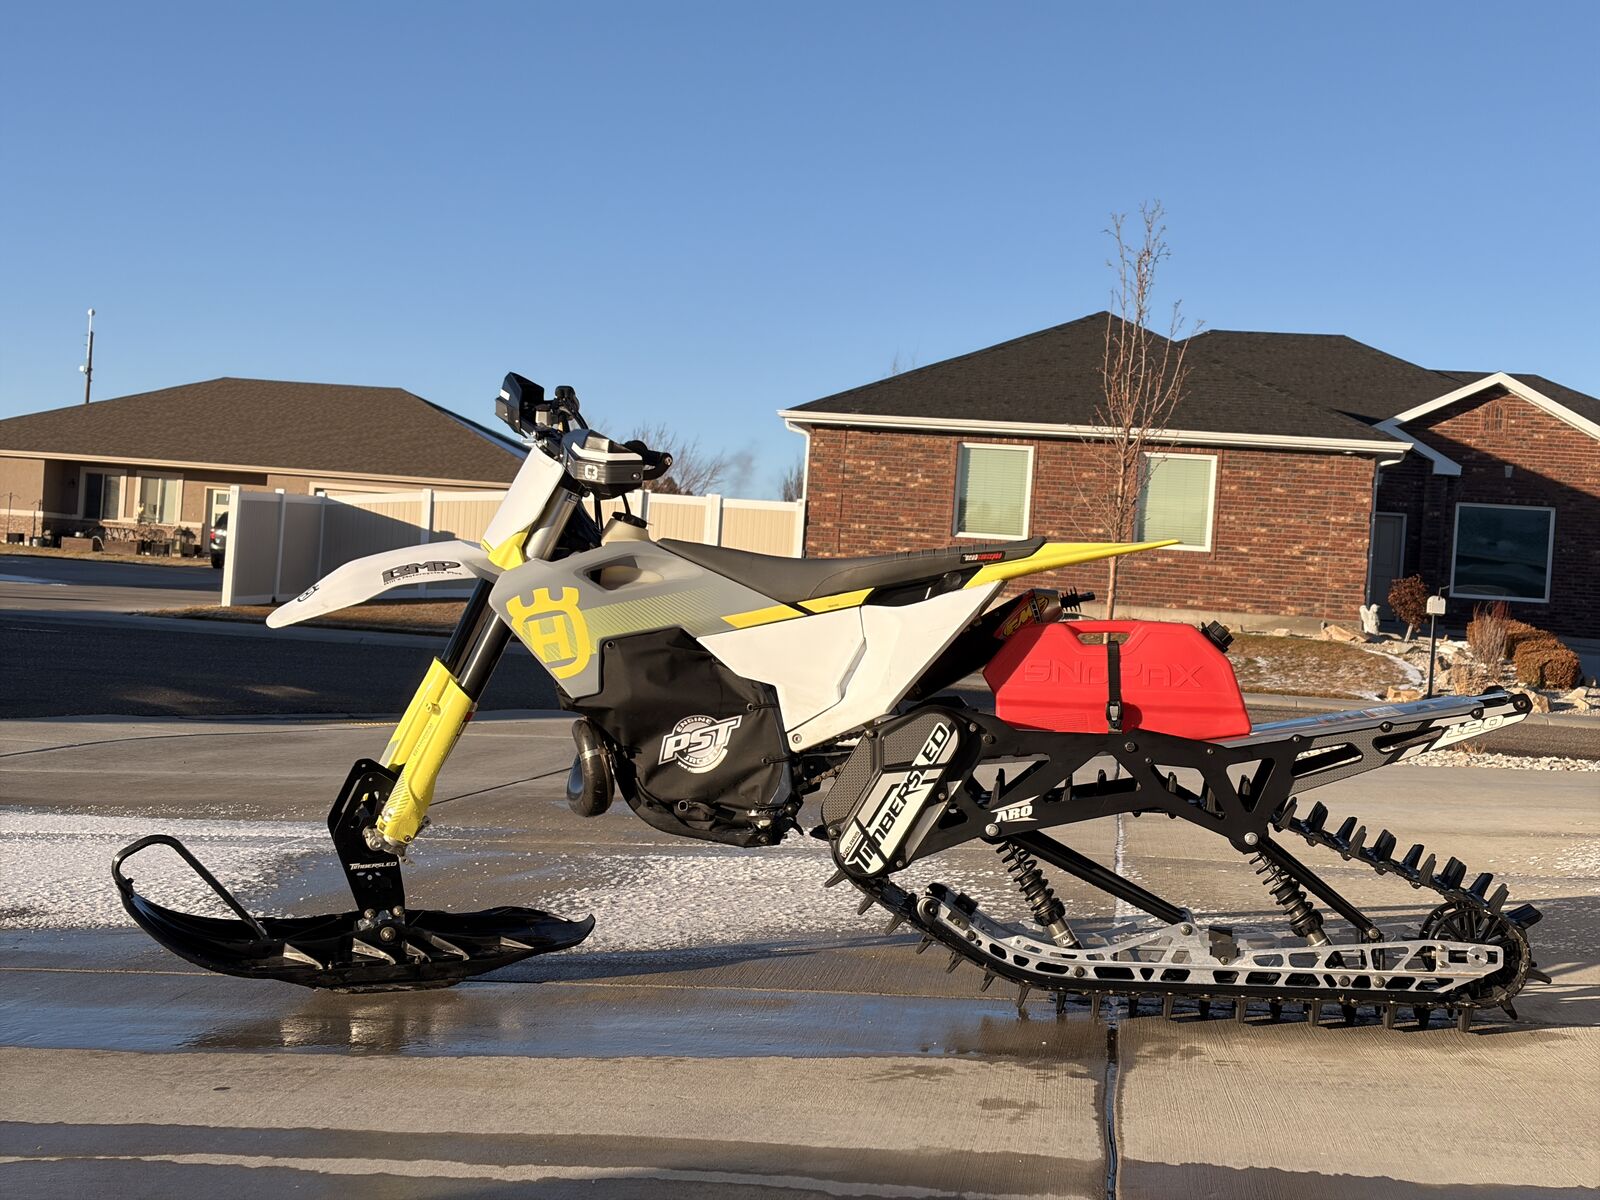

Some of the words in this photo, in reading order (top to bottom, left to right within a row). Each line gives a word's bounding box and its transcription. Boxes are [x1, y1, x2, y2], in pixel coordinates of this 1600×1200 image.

[382, 561, 461, 583] BMP
[676, 717, 712, 733] ENGINE
[1446, 715, 1505, 738] 120
[663, 719, 738, 761] PST
[994, 805, 1033, 823] ARO
